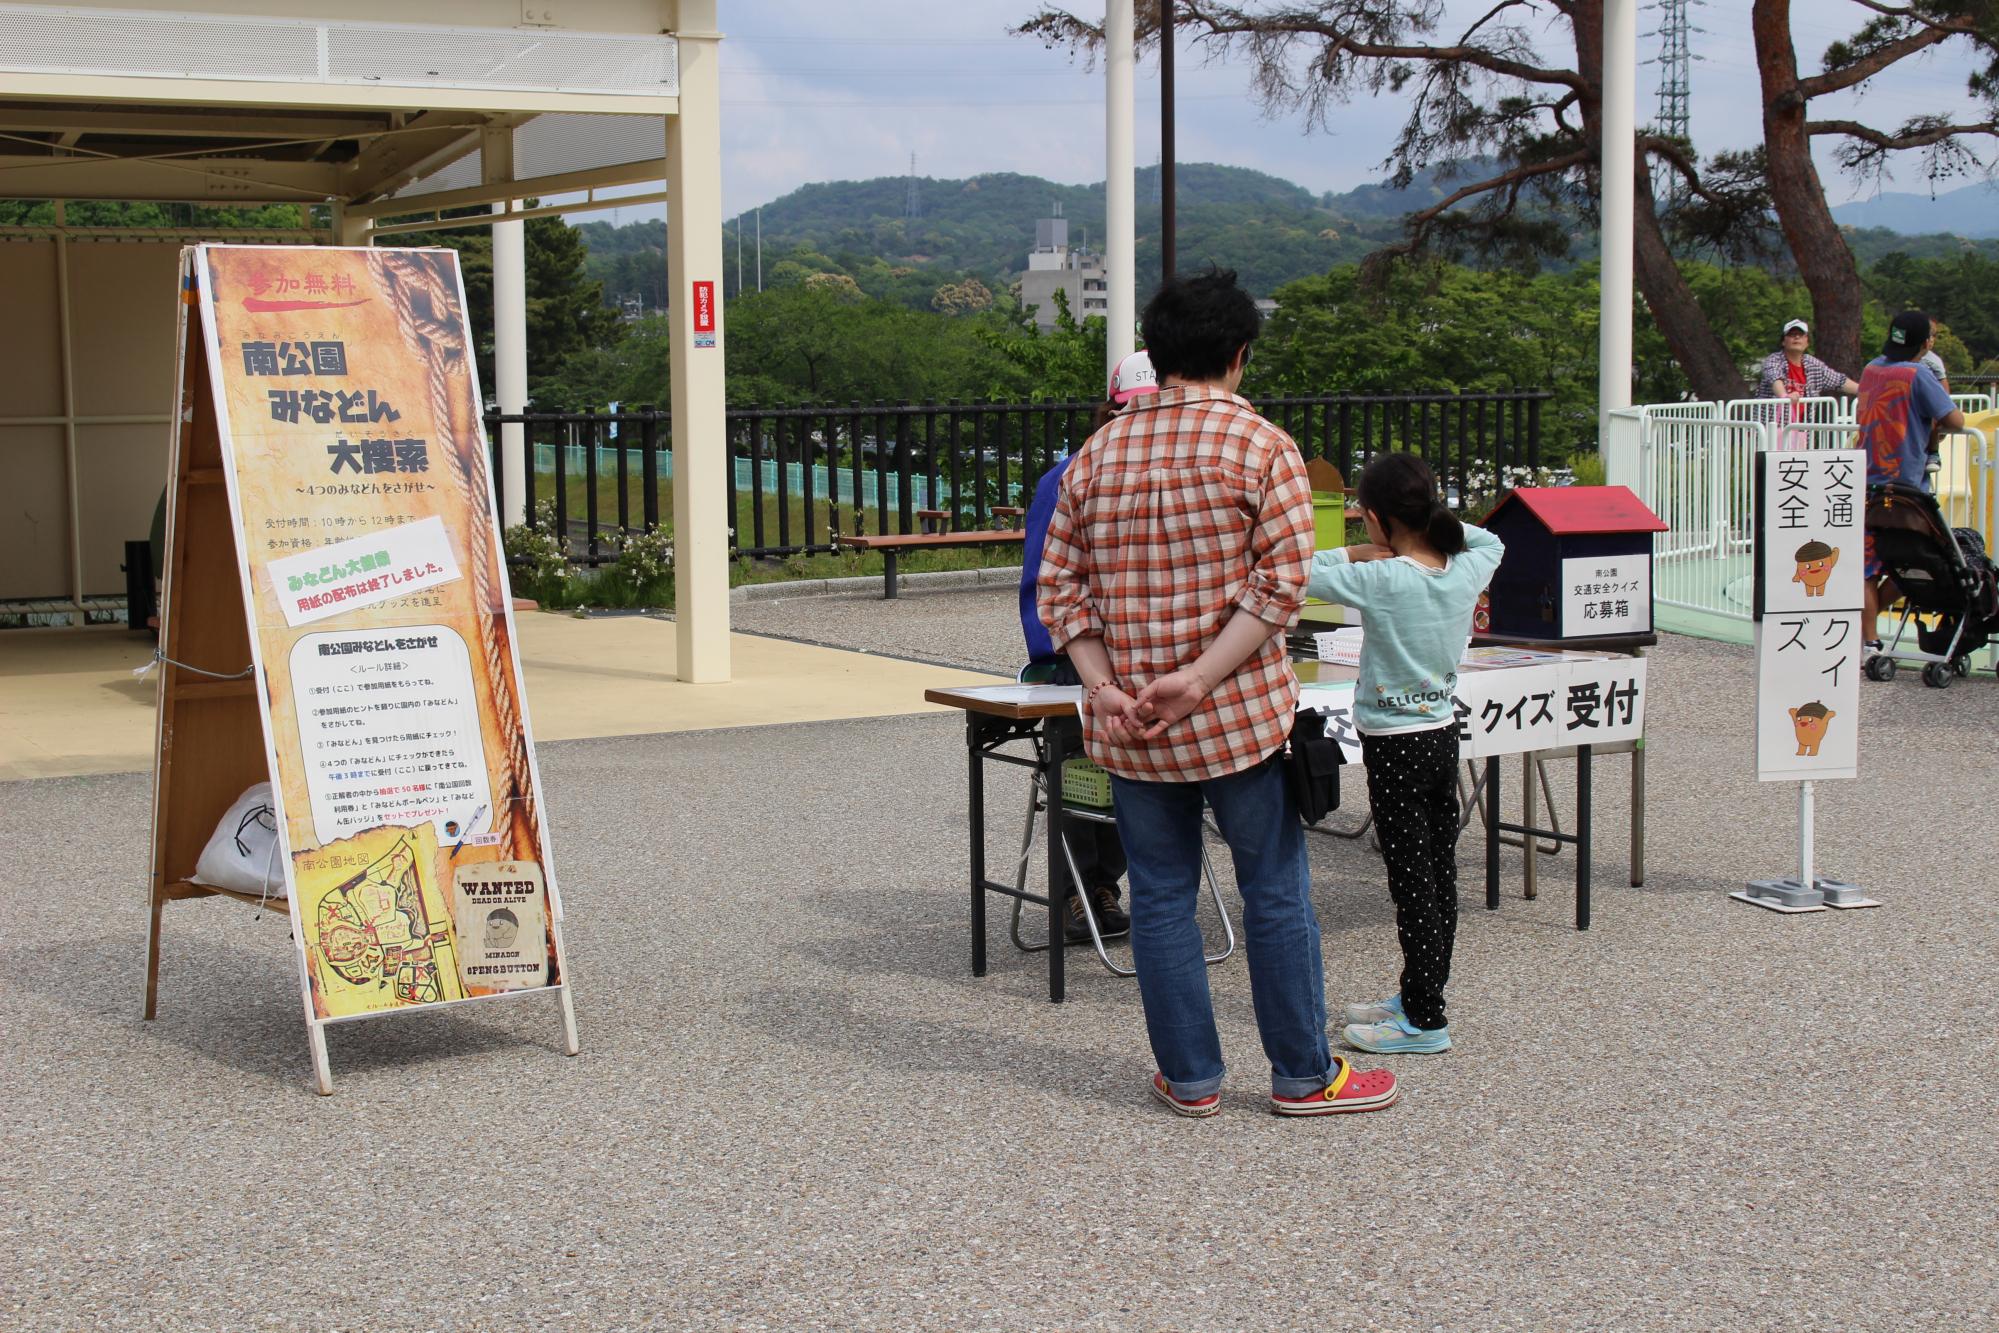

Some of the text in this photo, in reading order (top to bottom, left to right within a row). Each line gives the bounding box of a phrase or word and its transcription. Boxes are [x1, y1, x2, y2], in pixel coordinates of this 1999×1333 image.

[250, 273, 356, 296] 参加無料
[241, 341, 348, 376] 南公園
[267, 389, 400, 424] みなどん
[327, 439, 429, 475] 大捜索
[1778, 457, 1809, 529] 安全
[1823, 456, 1854, 528] 交通
[1595, 568, 1618, 578] 南公園
[1574, 580, 1639, 596] 交通安全クイズ
[1583, 599, 1629, 619] 応募箱
[474, 835, 499, 845] 回数券
[302, 852, 370, 871] 南公園地図
[461, 880, 535, 896] WANTED
[485, 951, 520, 959] MINADON
